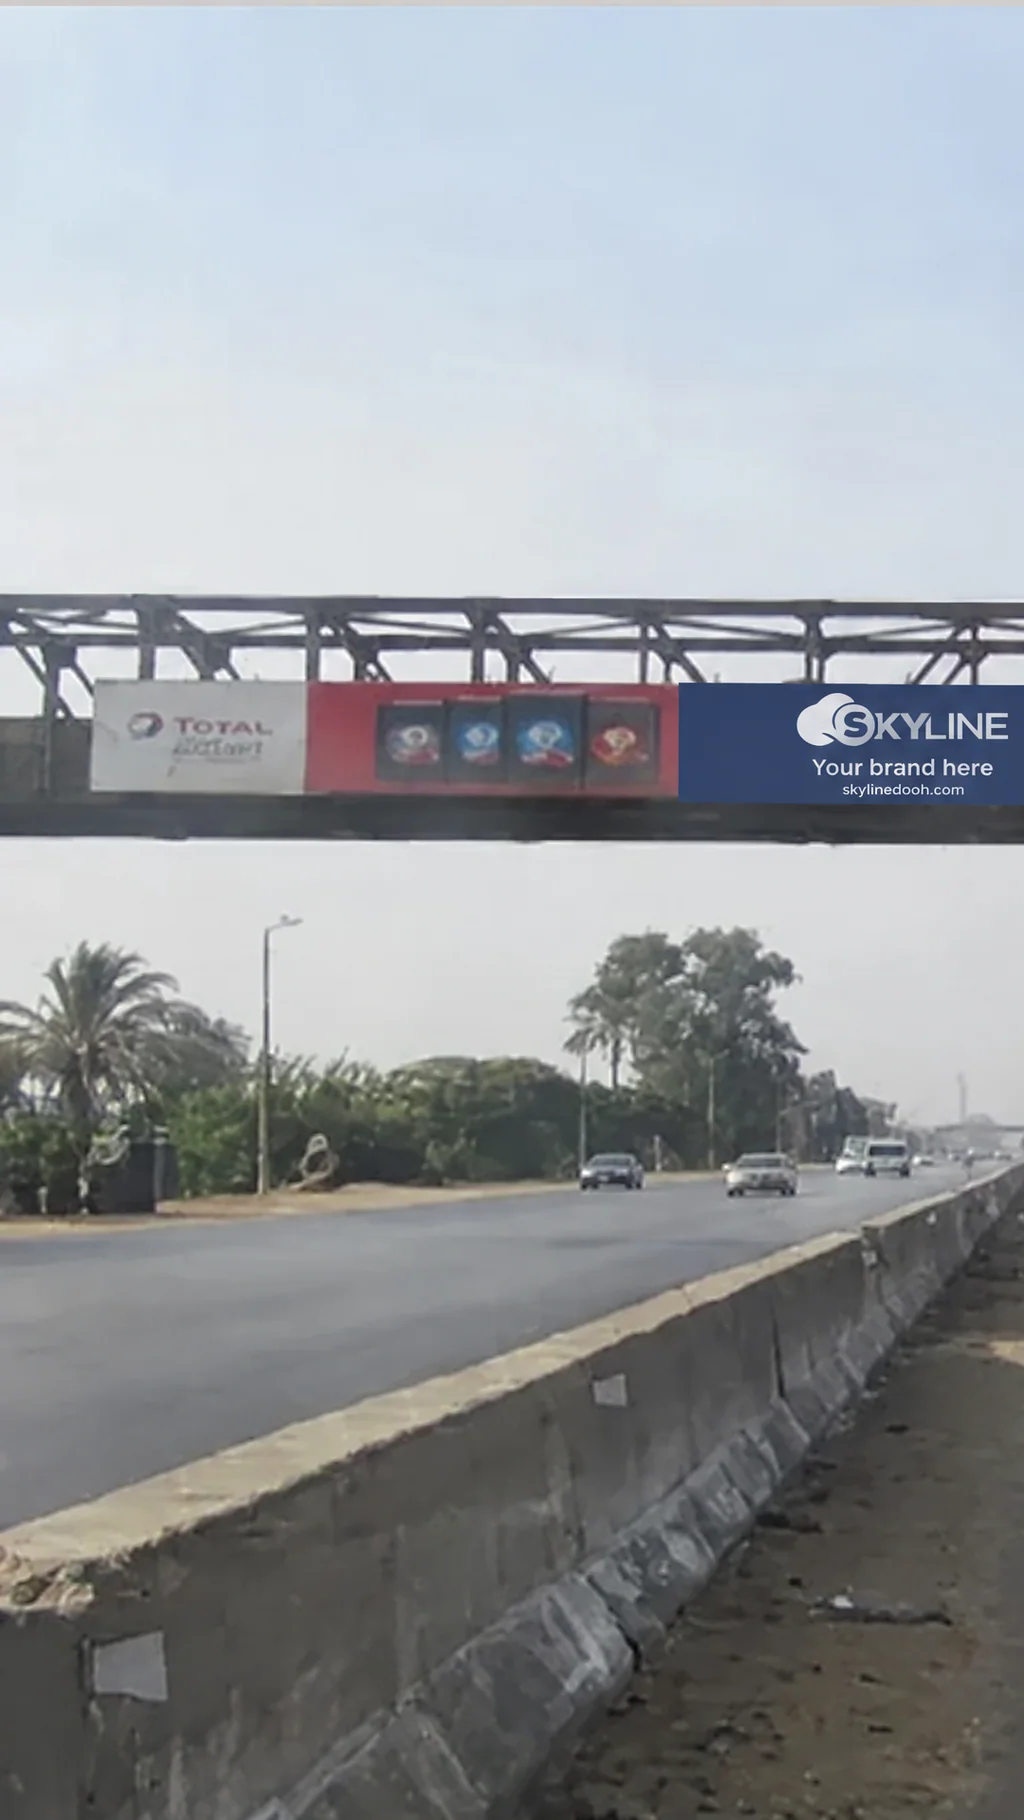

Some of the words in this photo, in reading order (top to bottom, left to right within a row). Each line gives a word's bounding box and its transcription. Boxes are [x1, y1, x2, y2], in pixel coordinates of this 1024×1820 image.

[173, 716, 274, 737] TOTAL
[842, 710, 1009, 741] SKYLINE
[812, 758, 863, 776] Your
[869, 757, 935, 777] brand
[943, 757, 994, 777] here
[842, 782, 965, 797] skylinedooh.com
